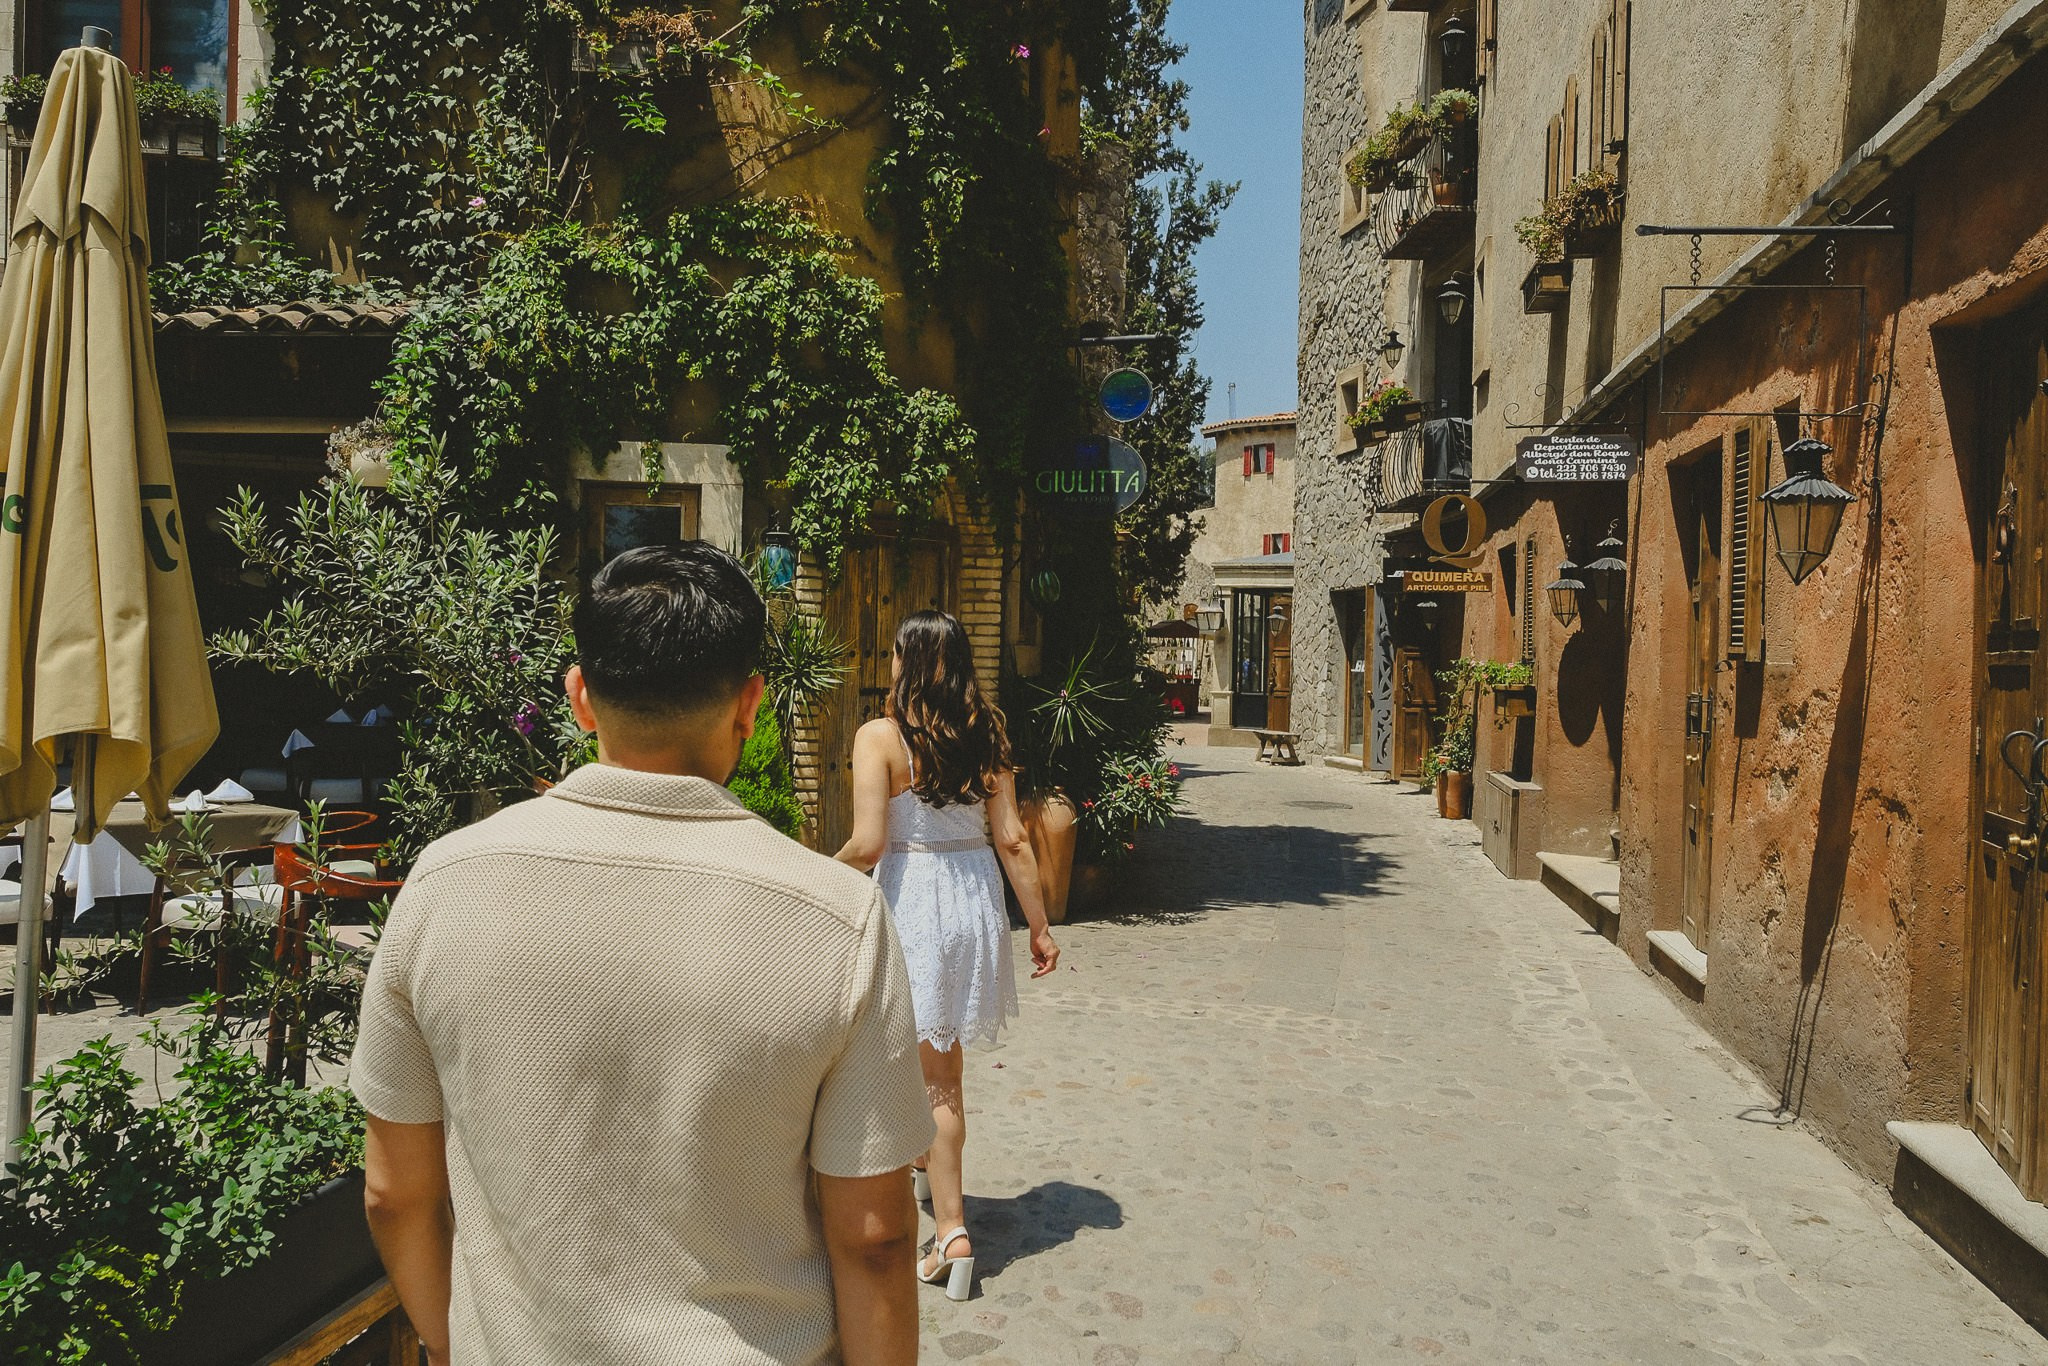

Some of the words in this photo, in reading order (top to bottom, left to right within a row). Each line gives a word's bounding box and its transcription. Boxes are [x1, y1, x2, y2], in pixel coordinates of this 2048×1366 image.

[1533, 443, 1621, 452] Departamentos
[1593, 450, 1630, 458] Roque
[1556, 464, 1577, 472] 222
[1579, 464, 1598, 472] 706
[1600, 464, 1626, 472] 7430
[1556, 472, 1577, 480] 222
[1579, 472, 1598, 480] 706
[1600, 472, 1626, 480] 7874
[1036, 470, 1140, 493] GIULITTA
[1422, 494, 1487, 568] Q
[1412, 572, 1485, 582] QUIMERA
